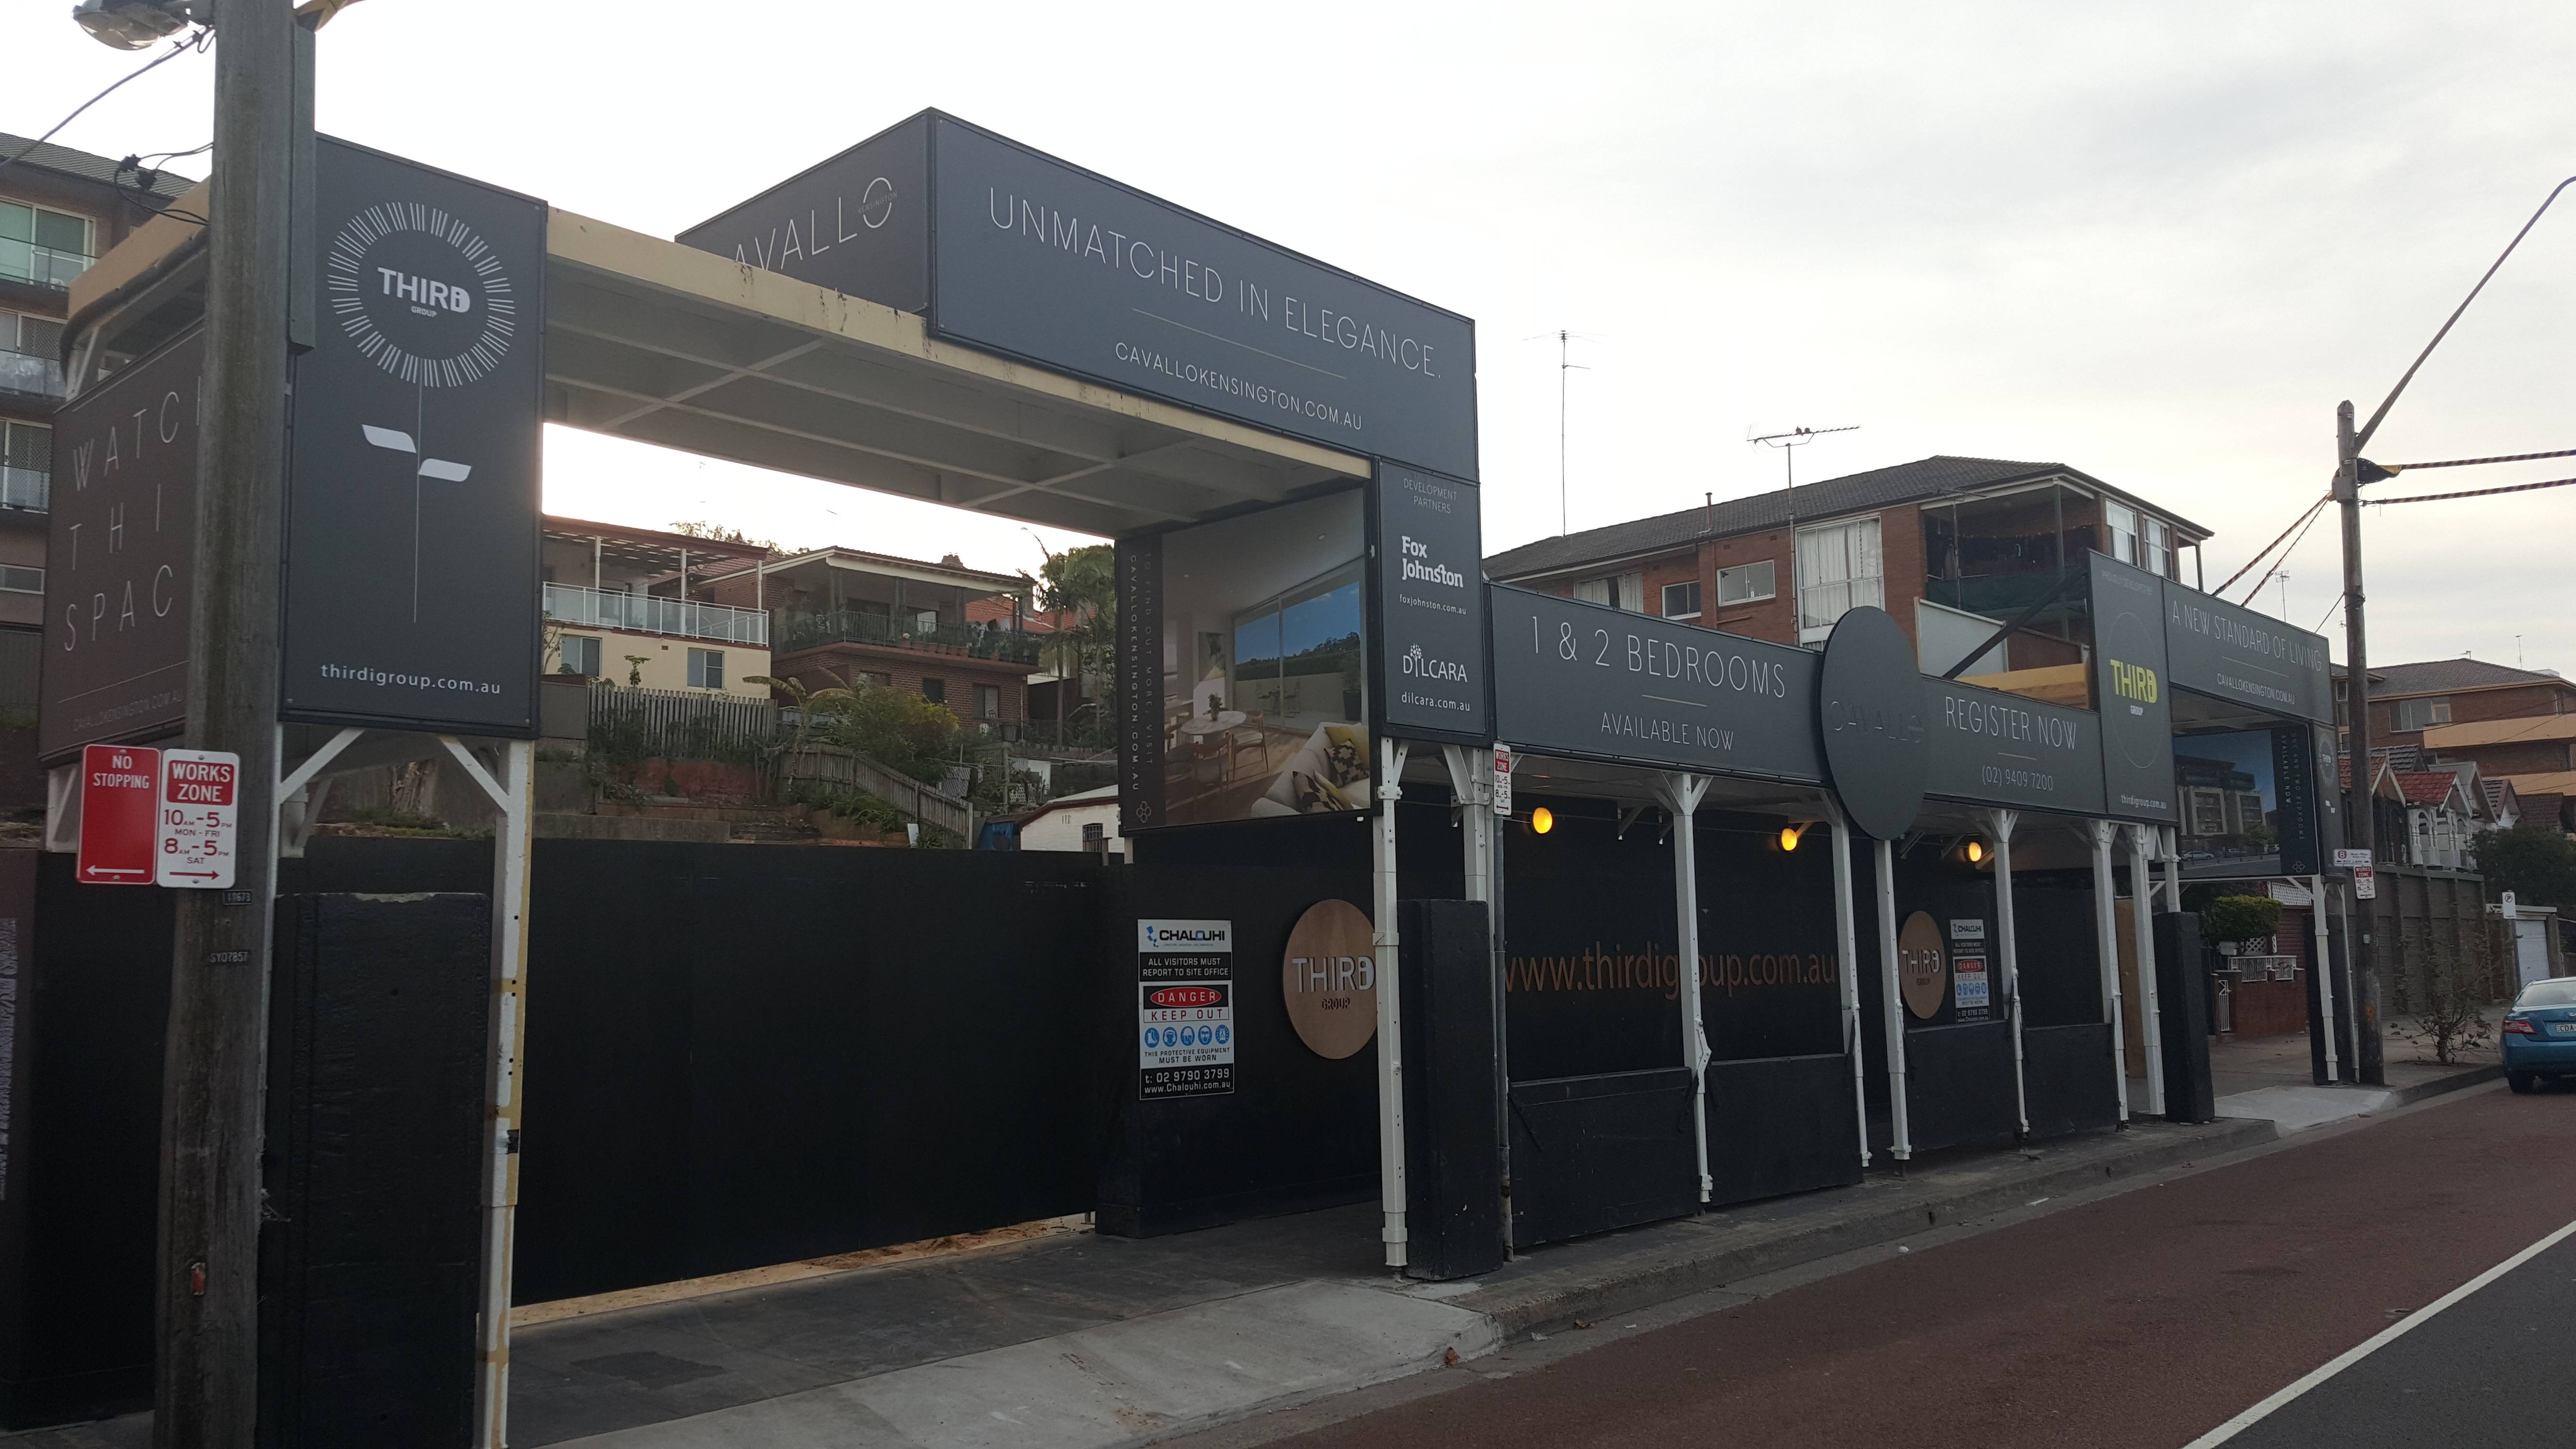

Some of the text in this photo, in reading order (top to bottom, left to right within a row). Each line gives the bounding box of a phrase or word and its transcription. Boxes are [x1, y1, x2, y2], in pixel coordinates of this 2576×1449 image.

[989, 186, 1442, 380] UNMATCHED IN ELEGANCE.
[411, 306, 437, 317] GROUP
[1115, 342, 1363, 431] CAVALLOKENSINGTON.COM.AU
[1404, 478, 1457, 500] DEVELOPMENT
[1414, 496, 1451, 514] PARTNERS
[69, 483, 161, 571] THI
[1401, 535, 1427, 558] Fox
[1145, 552, 1151, 570] TO
[1401, 558, 1464, 588] Johnston
[64, 564, 173, 652] SPAC
[1400, 594, 1466, 615] foxjohnston.com.au
[2173, 600, 2321, 671] A NEW STANDARD OF LIVING
[1403, 650, 1468, 683] DILCARA
[1533, 616, 1785, 698] 1 & 2 BEDROOMS
[321, 664, 500, 694] thirdigroup.com.au
[1130, 555, 1139, 791] CAVALLOKENSINGTON.COM.AU
[2217, 673, 2295, 705] CAVALLOKENSINGTON.COM.AU
[1401, 692, 1470, 711] dilcara.com.au
[1601, 712, 1733, 751] AVAILABLE NOW
[1946, 696, 2077, 750] REGISTER NOW
[112, 755, 132, 769] NO
[1496, 750, 1509, 761] WORKS
[1497, 761, 1508, 771] ZONE
[2281, 735, 2290, 780] AVAILABLE
[93, 773, 150, 789] STOPPING
[172, 762, 231, 783] WORKS
[1982, 766, 2053, 790] (02) 9409 7200
[177, 784, 223, 802] ZONE
[2121, 794, 2166, 809] thirdigroup.com.au
[205, 829, 221, 837] FRI
[1159, 930, 1225, 941] CHALOUHI
[1143, 968, 1172, 977] REPORT
[1204, 967, 1228, 976] OFFICE
[1148, 958, 1162, 966] ALL
[1505, 941, 1835, 1000] ww.thirdigoup.com.au
[1158, 992, 1216, 1002] DANGER
[1322, 998, 1351, 1010] GROUP
[1151, 1009, 1223, 1021] KEEP OUT
[1145, 1068, 1229, 1083] t: 02 9790 3799
[1144, 1081, 1230, 1094] www.Chalouhi.com.au
